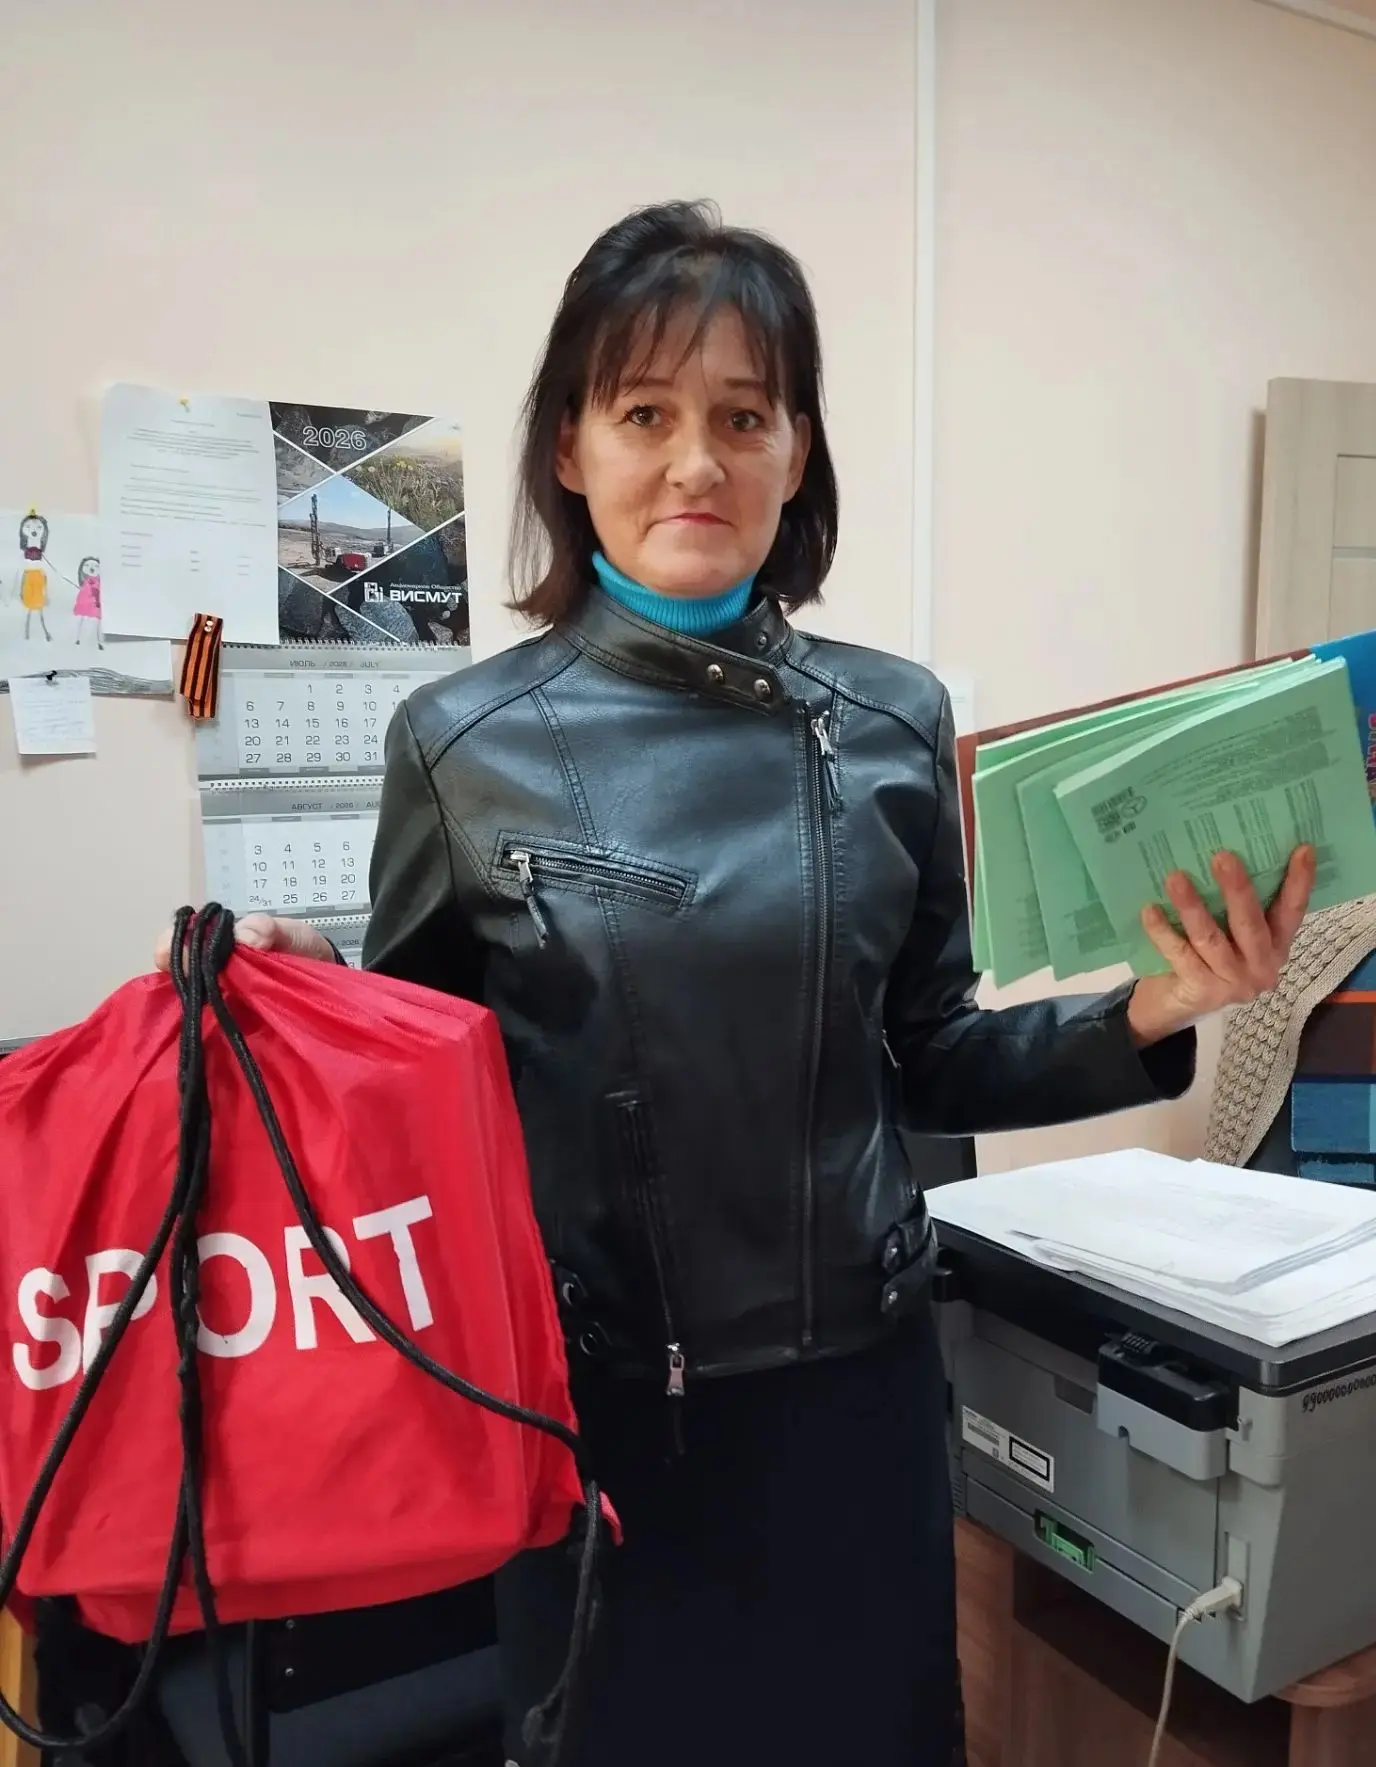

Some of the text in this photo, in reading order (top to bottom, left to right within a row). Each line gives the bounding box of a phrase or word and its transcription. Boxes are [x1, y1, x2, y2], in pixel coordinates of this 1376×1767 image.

[303, 426, 366, 450] 2026
[389, 590, 462, 603] ВИСМУТ
[307, 684, 400, 694] 1 2 3 4
[246, 701, 254, 711] 6
[277, 701, 285, 711] 7
[307, 701, 315, 711] 8
[337, 701, 344, 711] 9
[363, 701, 376, 711] 10
[245, 718, 376, 728] 13 14 15 16 17
[245, 735, 378, 746] 20 21 22 23 24
[246, 752, 377, 763] 27 28 29 30 31
[254, 841, 350, 855] 3 4 5 6
[253, 858, 354, 872] 10 11 12 13
[254, 874, 355, 888] 17 18 19 20
[283, 894, 298, 904] 25
[313, 892, 327, 902] 26
[341, 890, 356, 900] 27
[13, 1195, 434, 1390] SPORT
